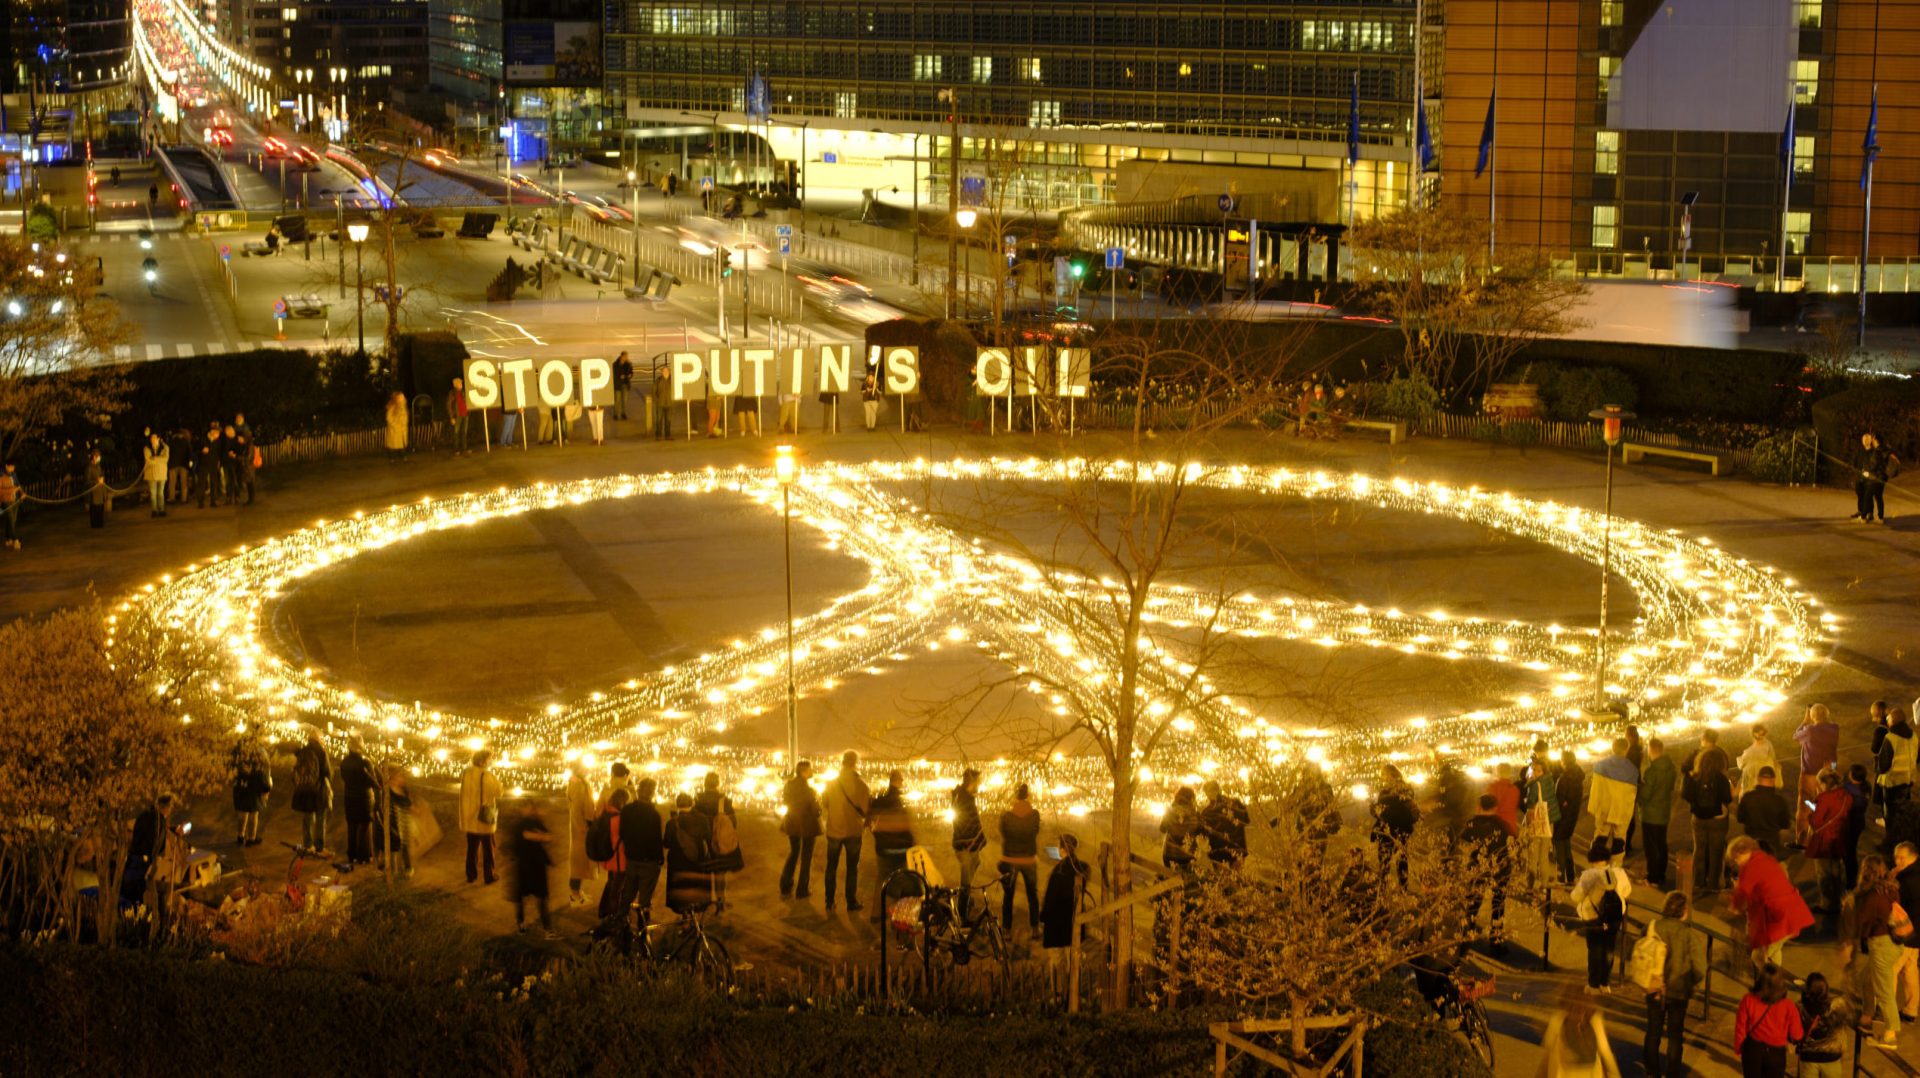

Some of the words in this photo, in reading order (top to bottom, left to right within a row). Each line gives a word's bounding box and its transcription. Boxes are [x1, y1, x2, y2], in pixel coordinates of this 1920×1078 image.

[780, 238, 789, 251] P
[468, 359, 611, 407] STOP
[673, 345, 917, 400] PUTIN'S
[976, 348, 1086, 396] OIL
